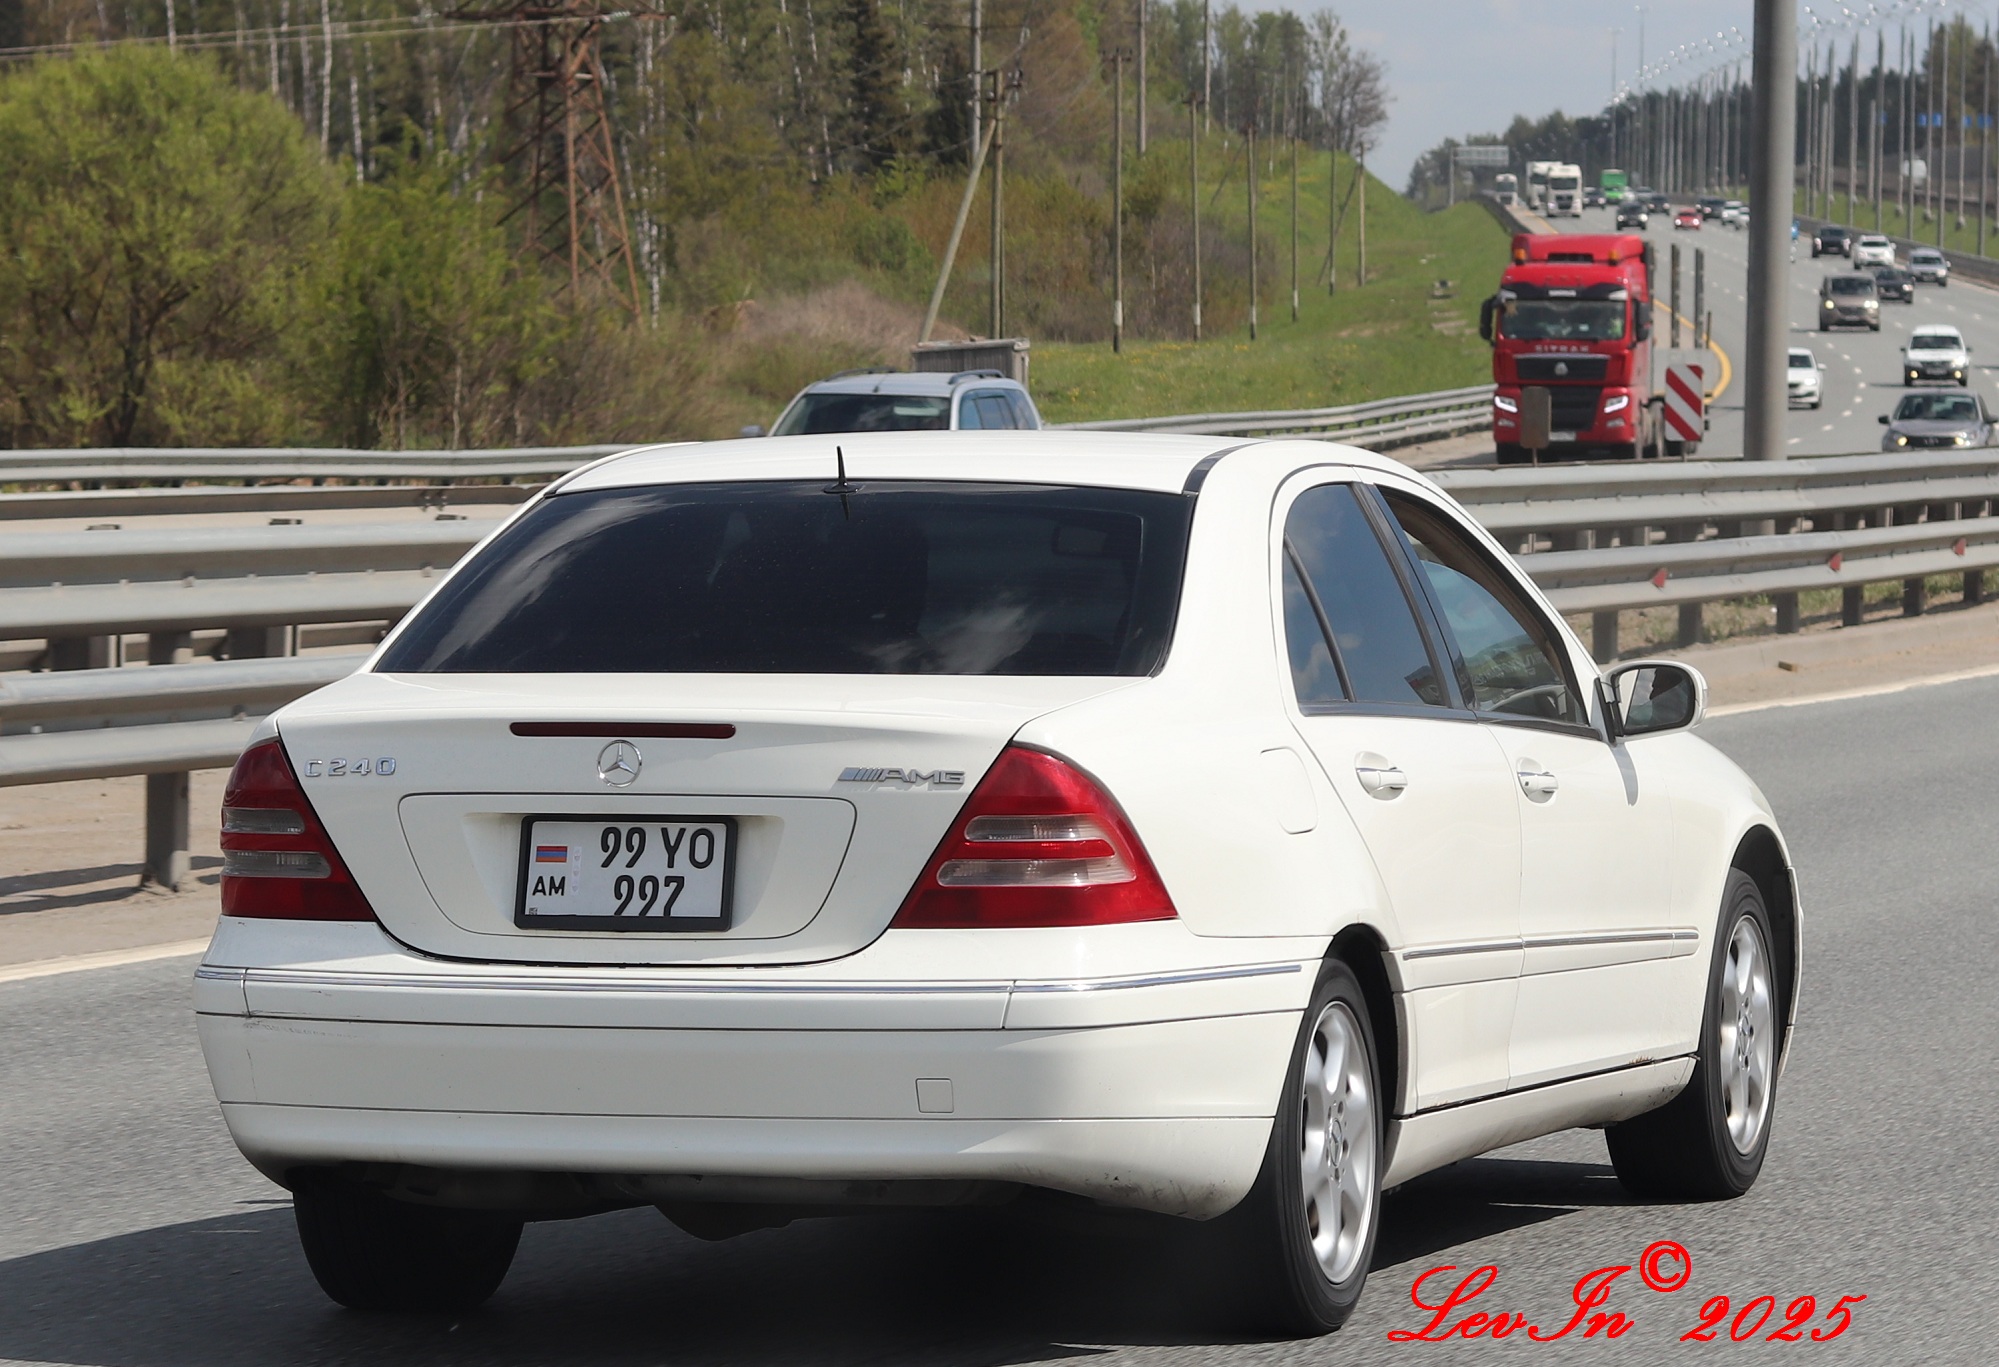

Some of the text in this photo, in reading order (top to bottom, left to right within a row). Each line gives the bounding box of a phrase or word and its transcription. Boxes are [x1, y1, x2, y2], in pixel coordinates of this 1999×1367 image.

[879, 767, 965, 785] AMG
[601, 826, 715, 869] 99 YO
[532, 875, 566, 896] AM
[614, 875, 685, 917] 997
